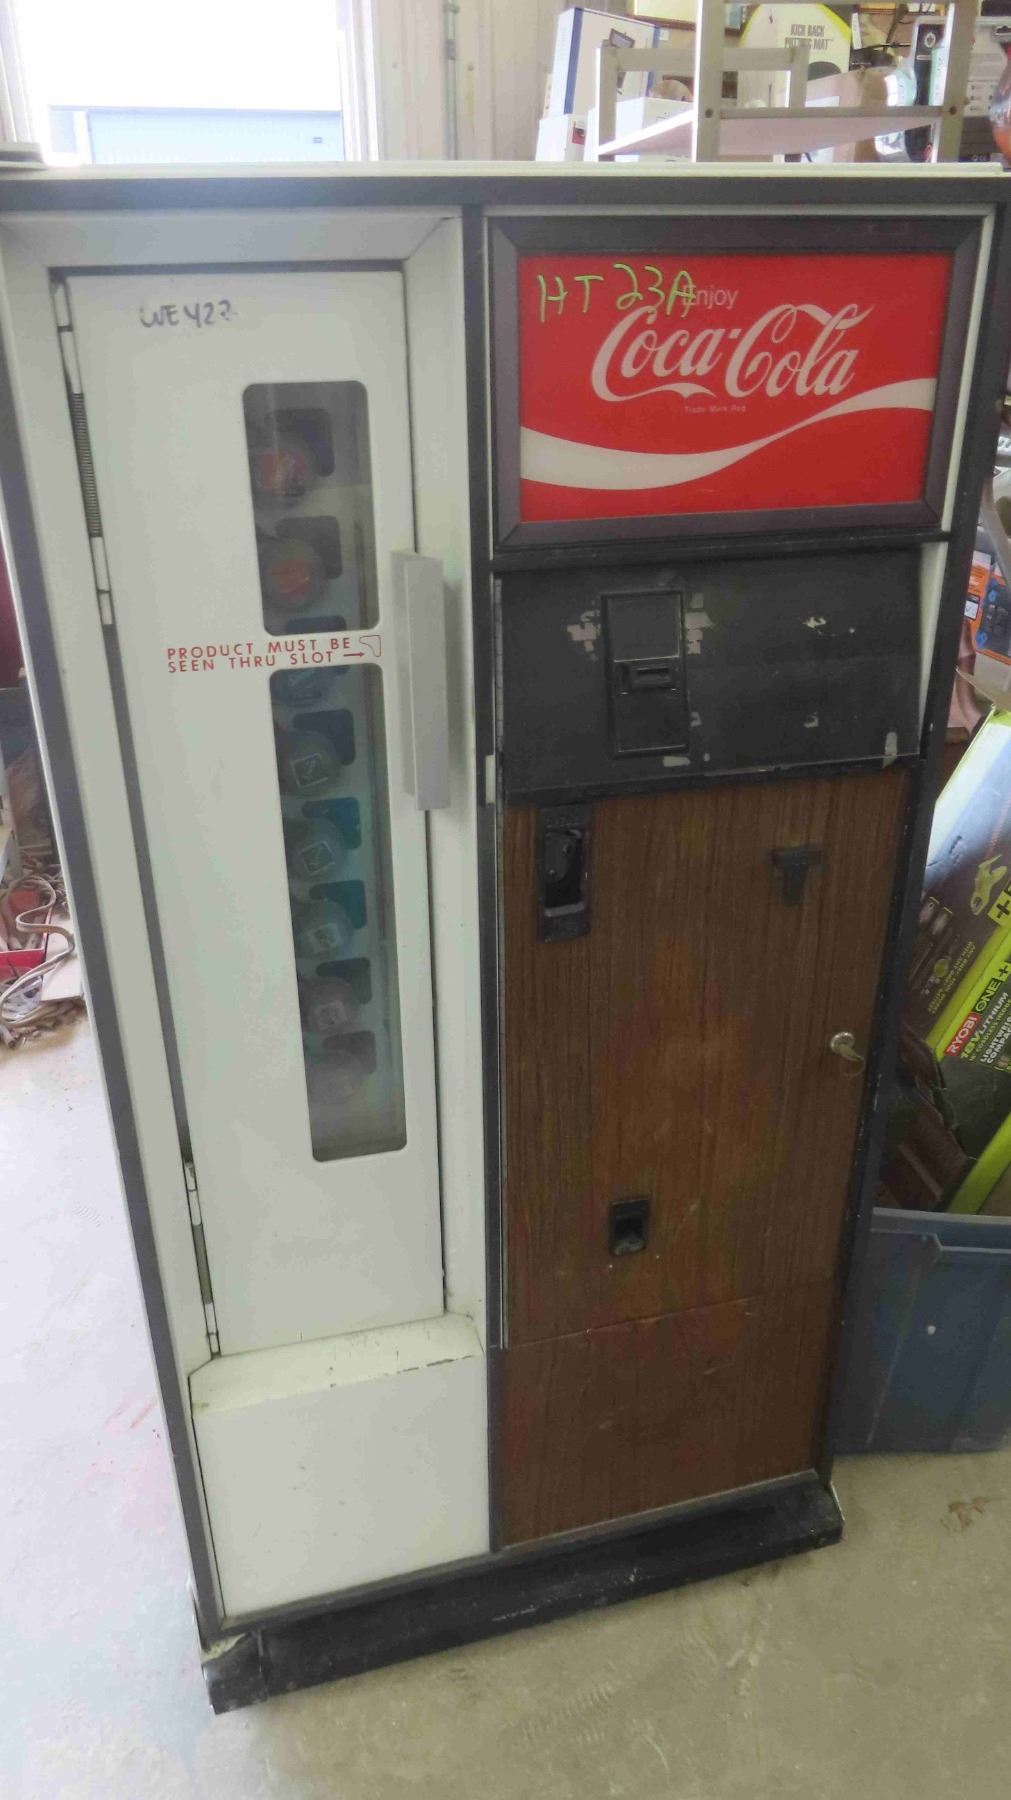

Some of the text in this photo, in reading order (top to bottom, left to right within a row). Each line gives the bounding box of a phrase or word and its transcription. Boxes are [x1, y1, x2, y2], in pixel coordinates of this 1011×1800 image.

[807, 24, 825, 37] BACK
[682, 284, 739, 309] Enjoy
[591, 303, 876, 402] Coca-Cola
[167, 637, 351, 660] PRODUCT MUST BE
[168, 651, 333, 673] SEEN THRU SLOT
[947, 1016, 978, 1053] RYOBI
